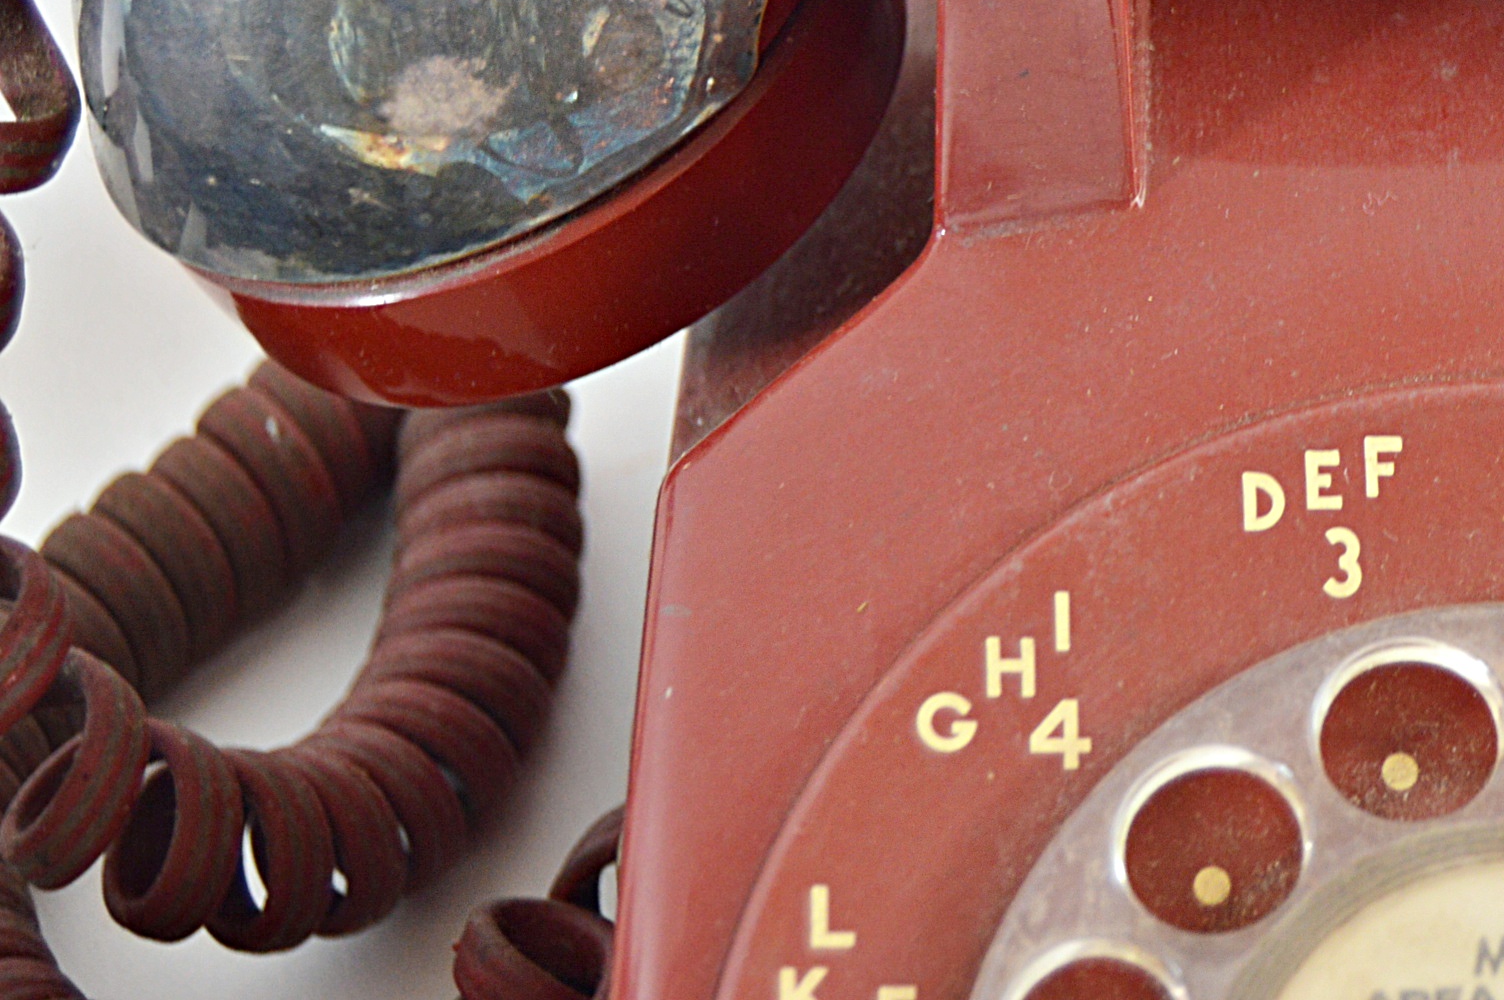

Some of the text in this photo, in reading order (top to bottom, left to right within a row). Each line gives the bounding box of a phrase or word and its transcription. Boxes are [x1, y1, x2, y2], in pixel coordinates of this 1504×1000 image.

[1241, 435, 1403, 532] DEF
[1322, 526, 1363, 599] 3
[1028, 698, 1093, 771] 4
